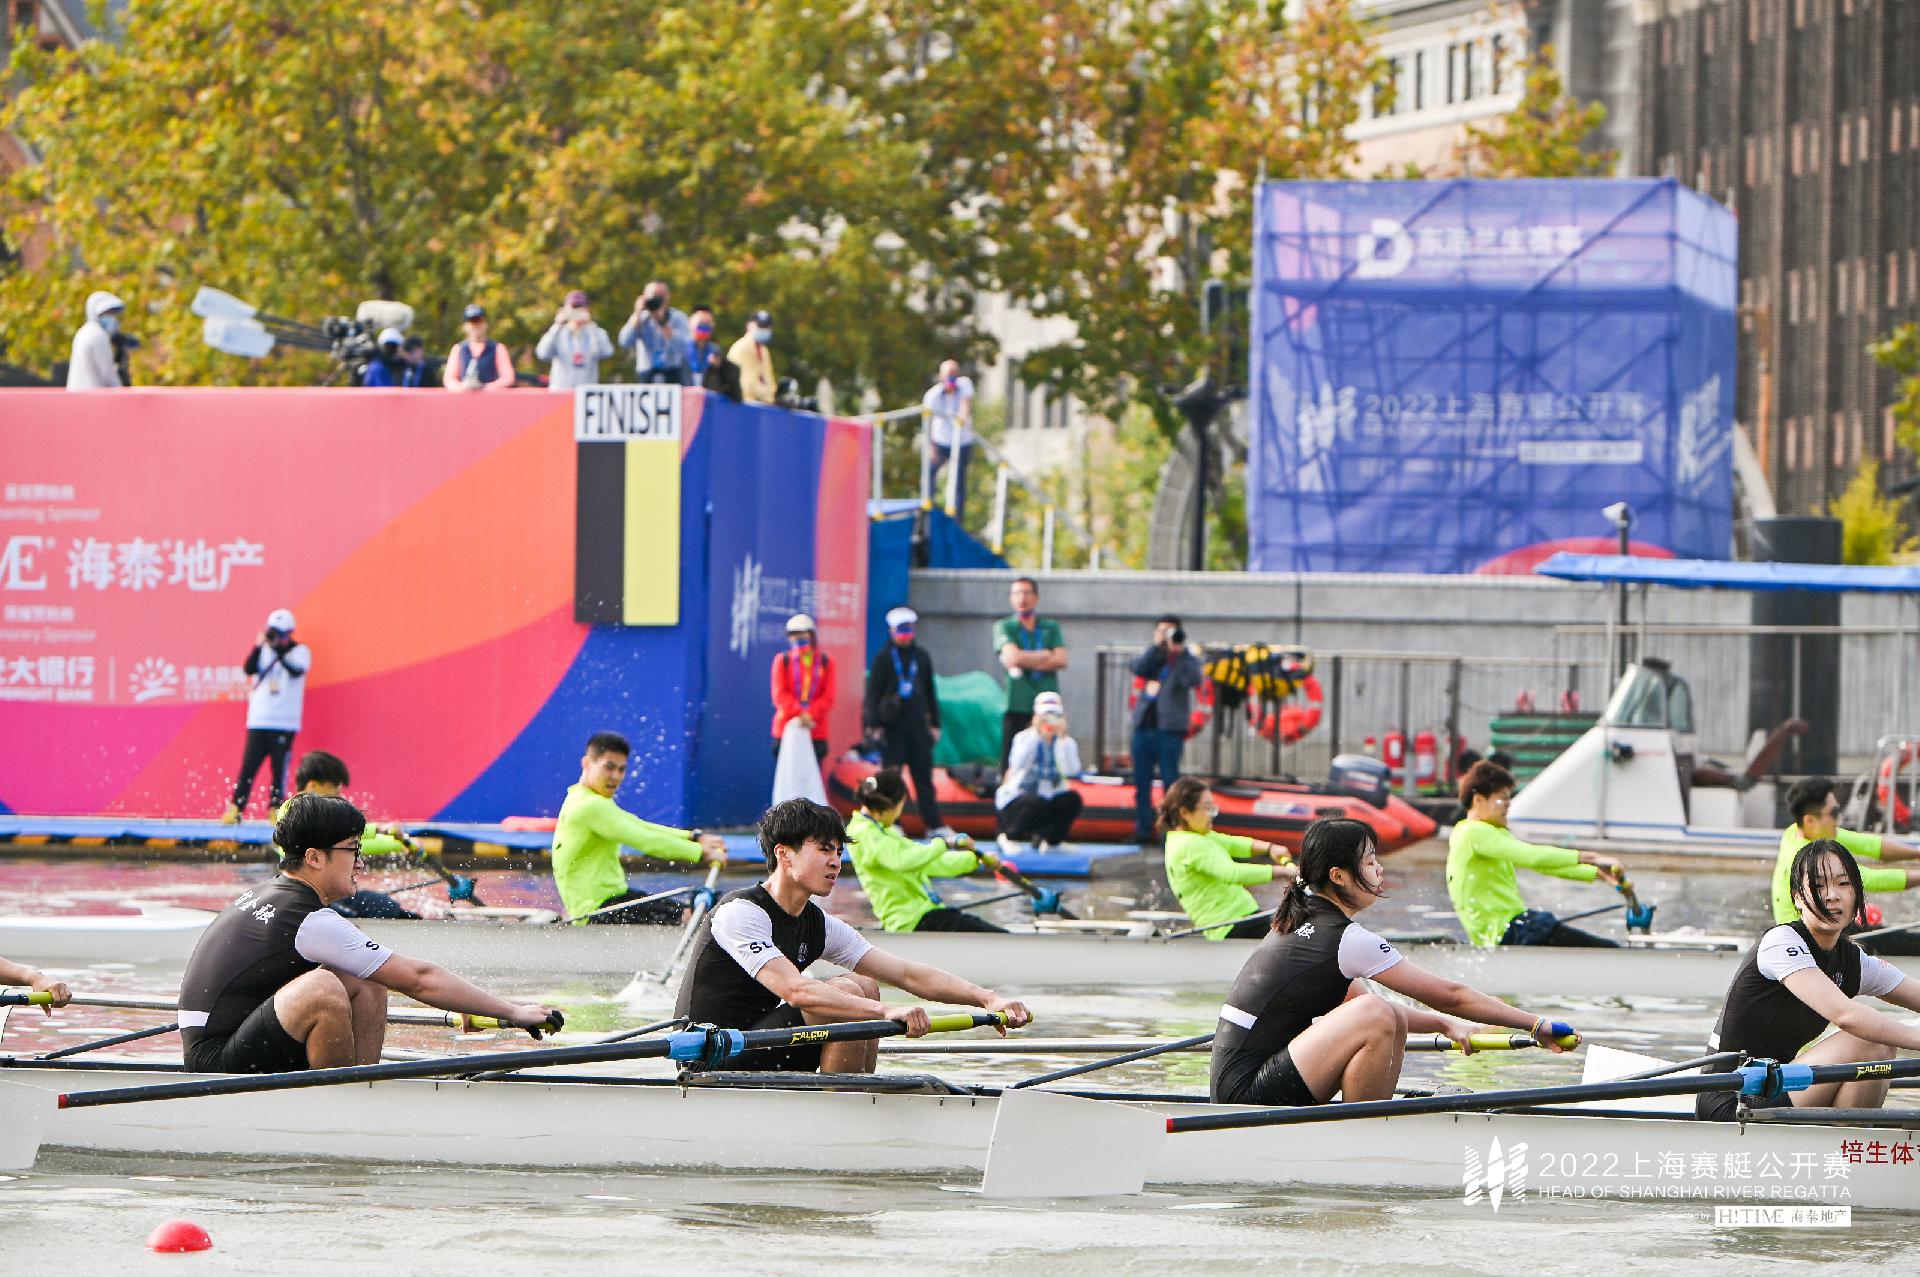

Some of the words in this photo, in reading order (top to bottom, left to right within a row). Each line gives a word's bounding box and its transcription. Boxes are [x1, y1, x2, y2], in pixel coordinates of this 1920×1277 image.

[584, 391, 672, 434] FINISH
[67, 536, 264, 591] 海泰地产
[0, 656, 95, 686] 大银行
[790, 1029, 829, 1044] FALCON
[1856, 1063, 1890, 1079] FALCON
[1840, 1139, 1920, 1165] 培生体
